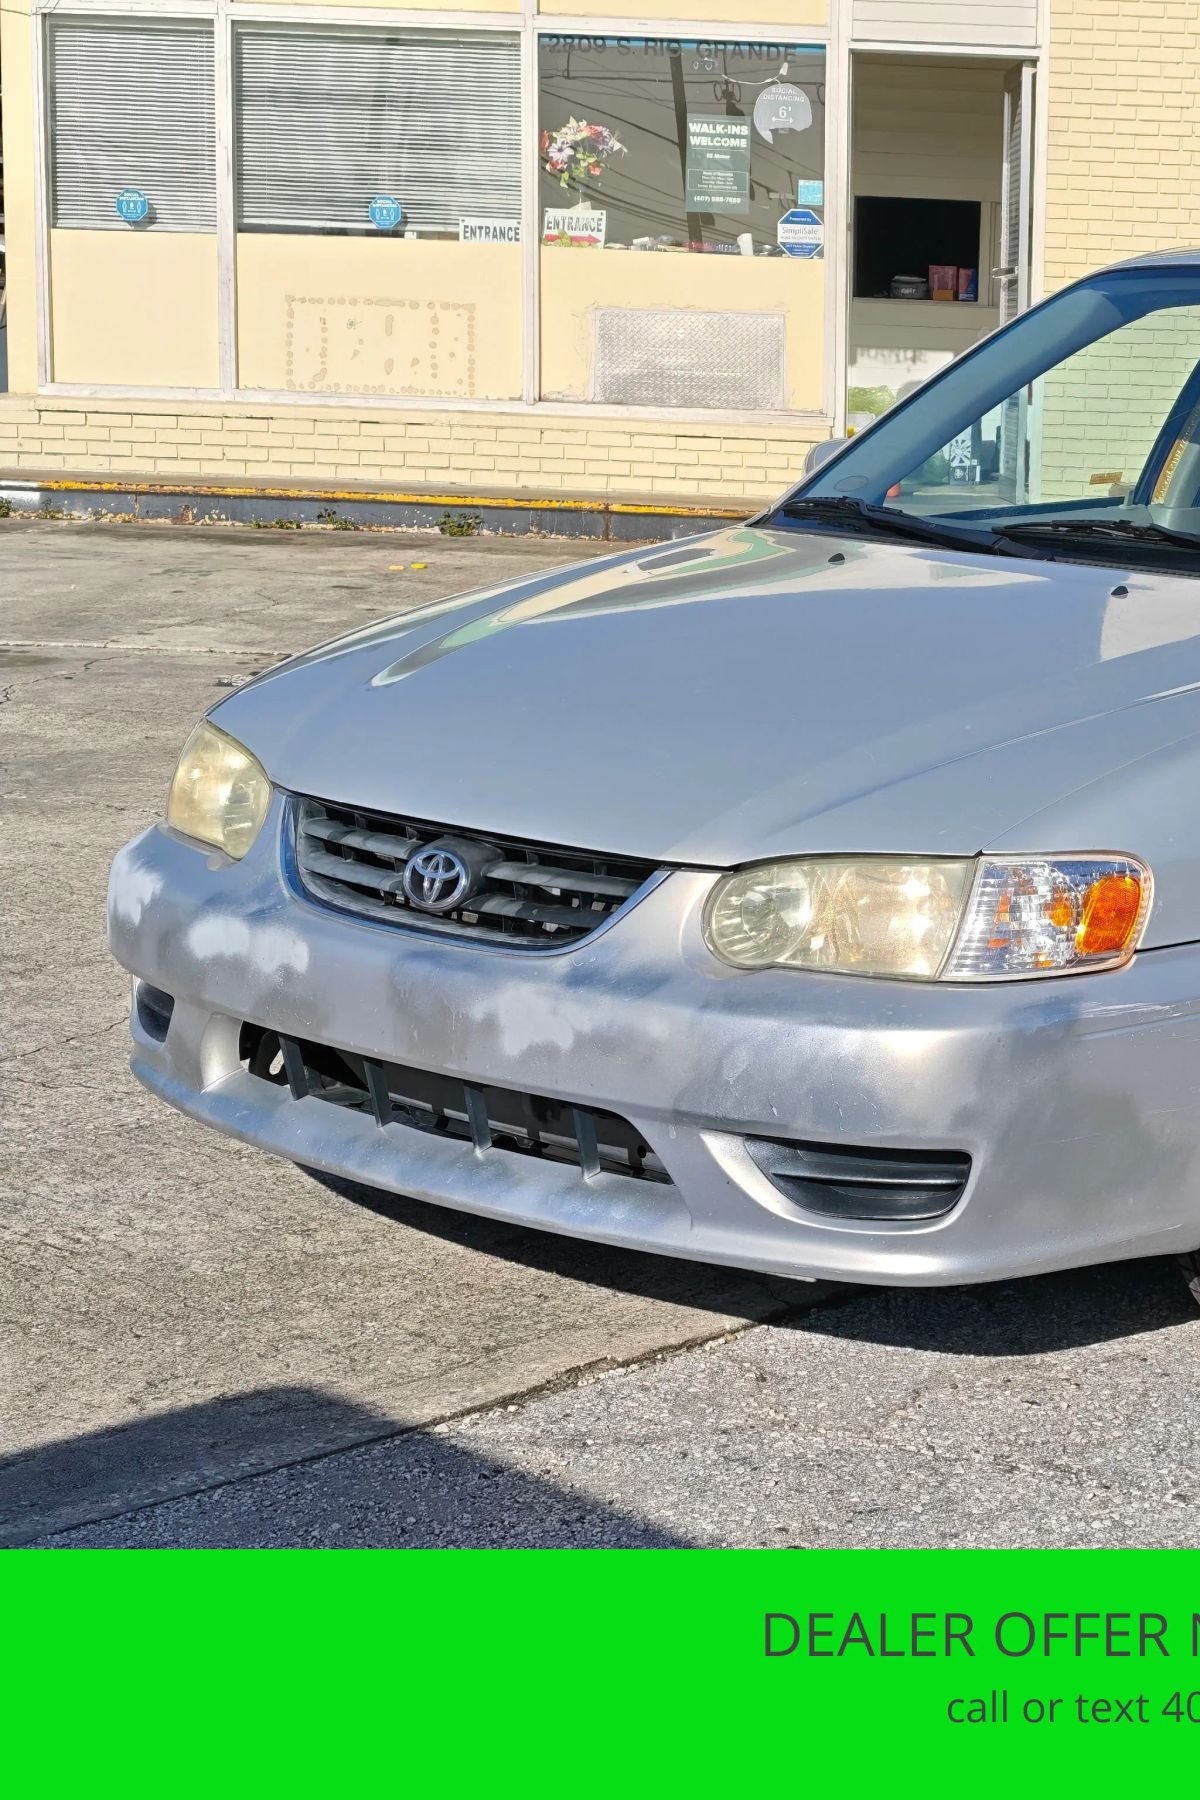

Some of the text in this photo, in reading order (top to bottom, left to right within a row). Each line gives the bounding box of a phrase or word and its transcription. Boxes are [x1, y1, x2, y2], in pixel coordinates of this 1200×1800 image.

[616, 37, 636, 56] S.
[643, 38, 682, 58] RIO
[696, 40, 797, 63] GRANDE
[763, 93, 806, 103] DISTANCING
[778, 105, 792, 119] 6'
[688, 122, 749, 136] WALK-INS
[689, 135, 748, 148] WELCOME
[546, 215, 603, 233] ENTRANCE
[782, 226, 818, 236] SimpliSafe
[463, 225, 520, 242] ENTRANCE
